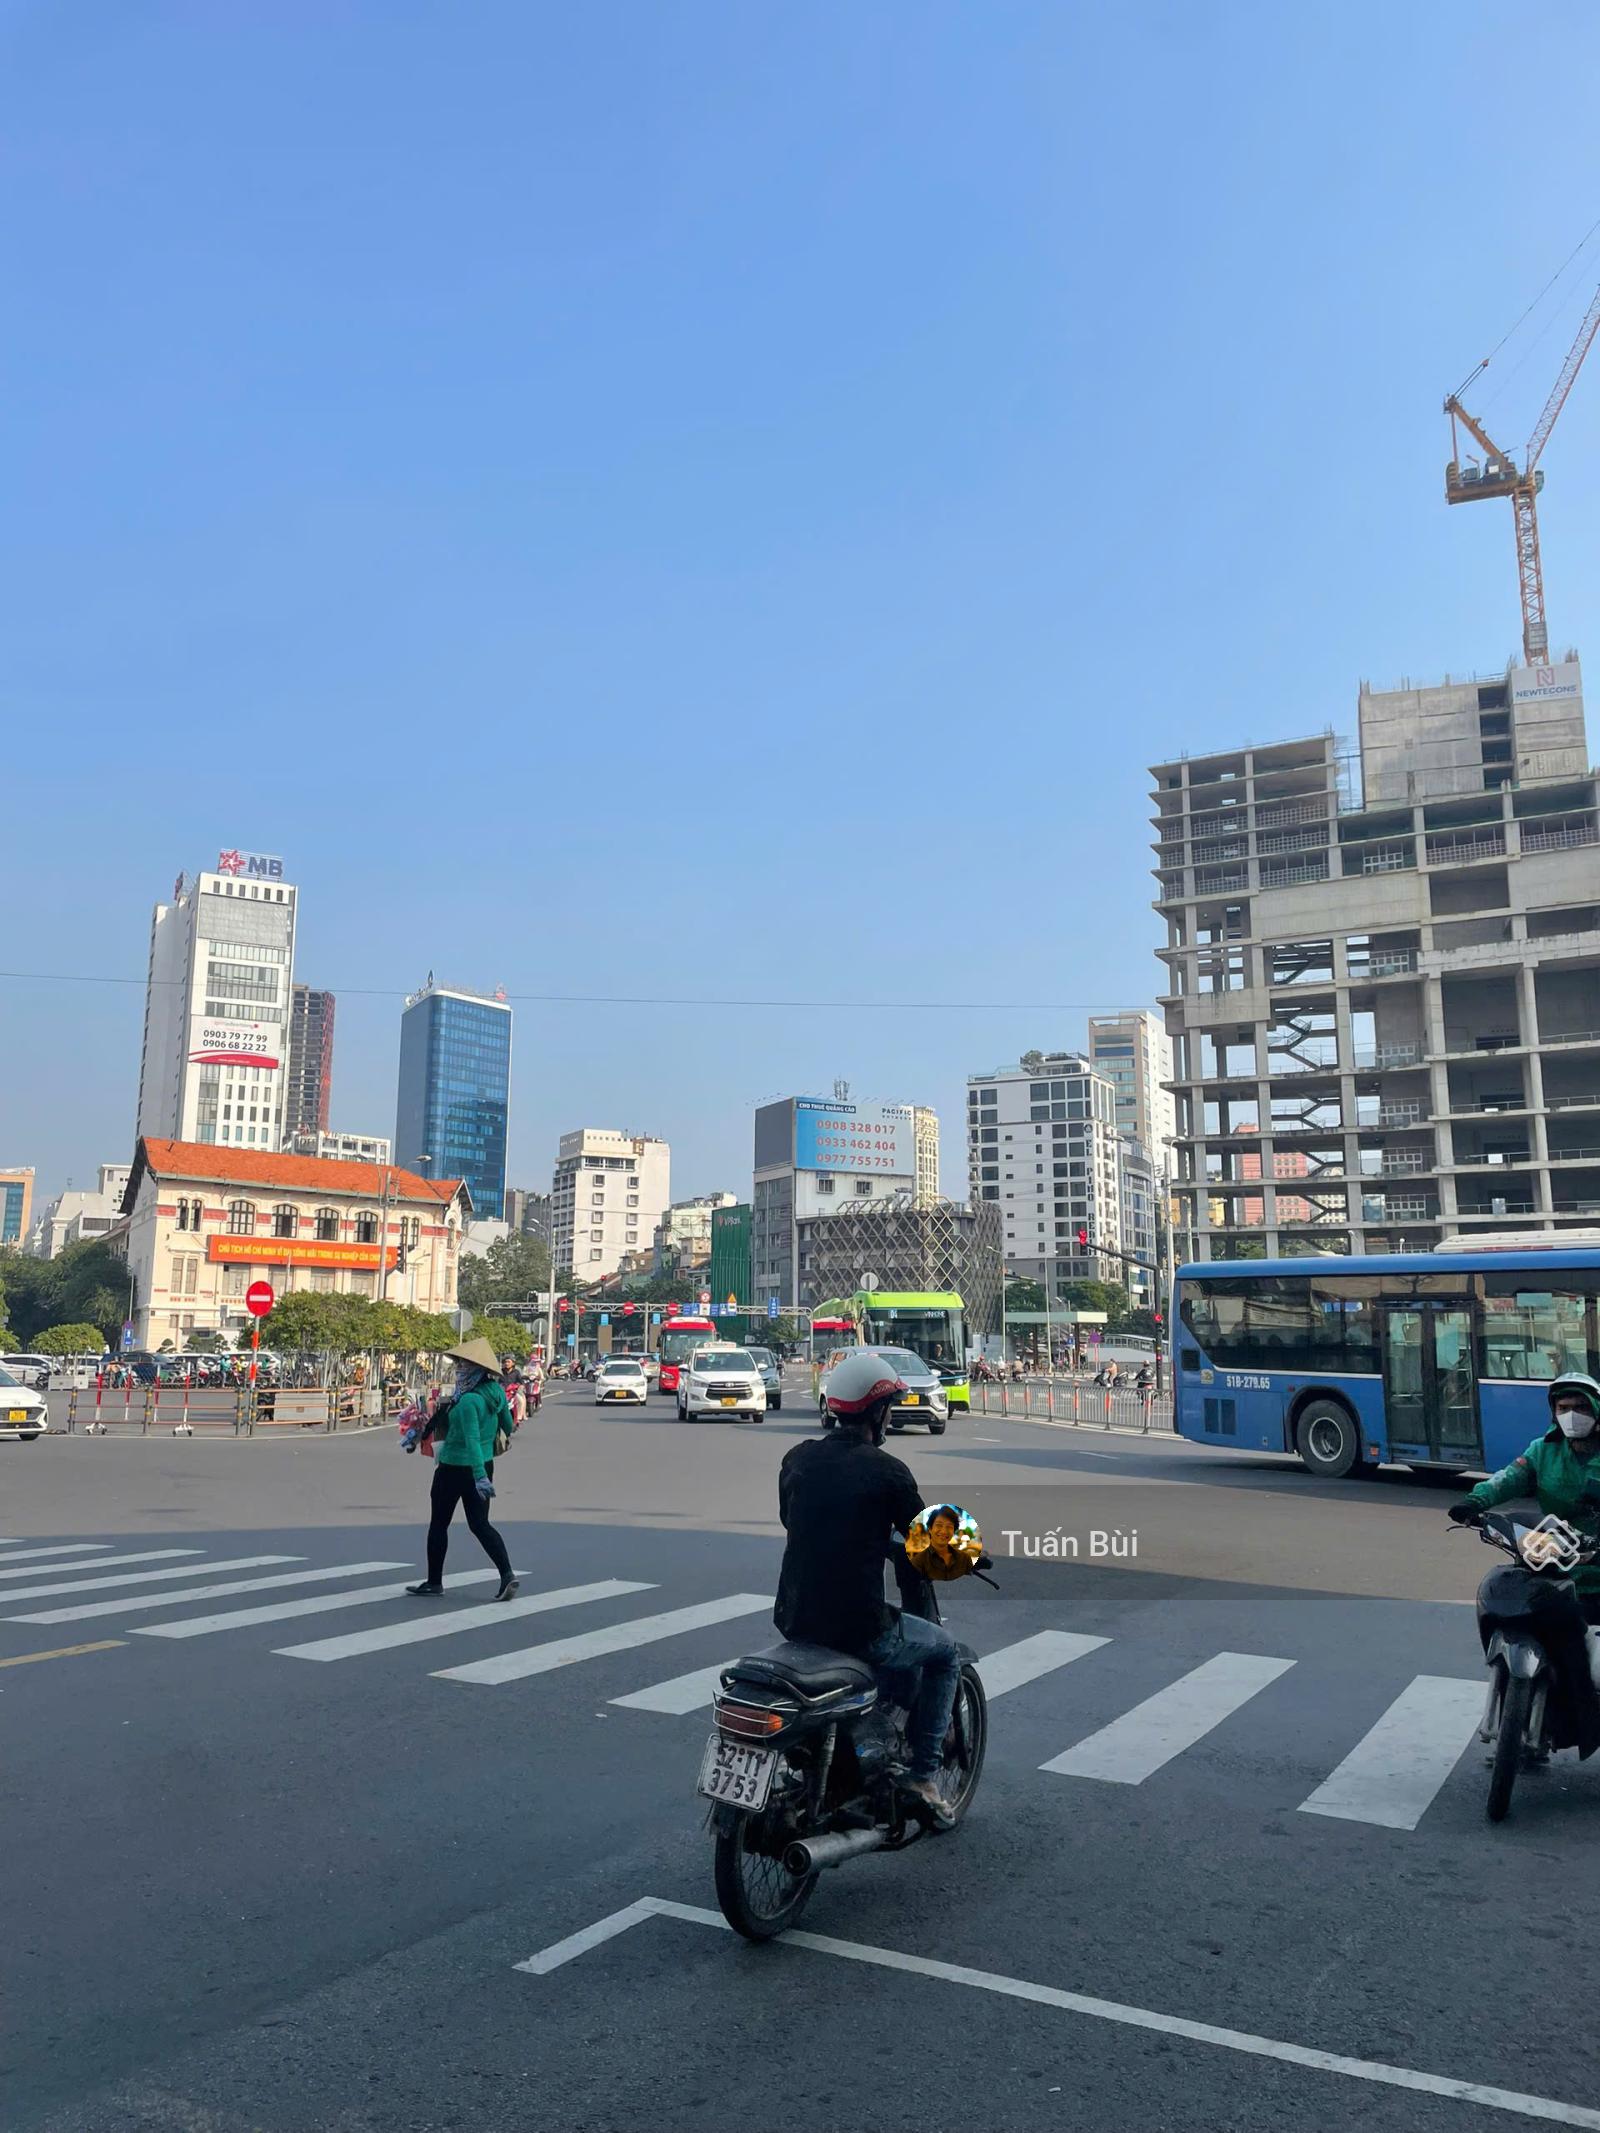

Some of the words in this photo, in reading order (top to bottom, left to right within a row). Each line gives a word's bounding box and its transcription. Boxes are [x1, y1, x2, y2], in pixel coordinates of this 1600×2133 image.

[1516, 684, 1577, 698] NEWTECONS
[248, 856, 284, 877] MB
[203, 1030, 227, 1039] 0903
[228, 1031, 240, 1040] 79
[242, 1033, 254, 1041] 77
[256, 1034, 268, 1042] 99
[202, 1039, 227, 1048] 0906
[228, 1041, 240, 1050] 68
[241, 1042, 254, 1051] 22
[255, 1044, 267, 1052] 22
[881, 1107, 912, 1116] PACIFIC
[816, 1120, 847, 1131] 0908
[849, 1122, 872, 1133] 328
[874, 1124, 896, 1135] 017
[816, 1136, 847, 1148] 0933
[849, 1139, 871, 1150] 462
[874, 1141, 896, 1151] 404
[816, 1153, 847, 1163] 0977
[849, 1155, 871, 1166] 755
[874, 1157, 895, 1167] 751
[1226, 1375, 1271, 1389] 51B-279.65
[708, 1768, 758, 1802] 3753
